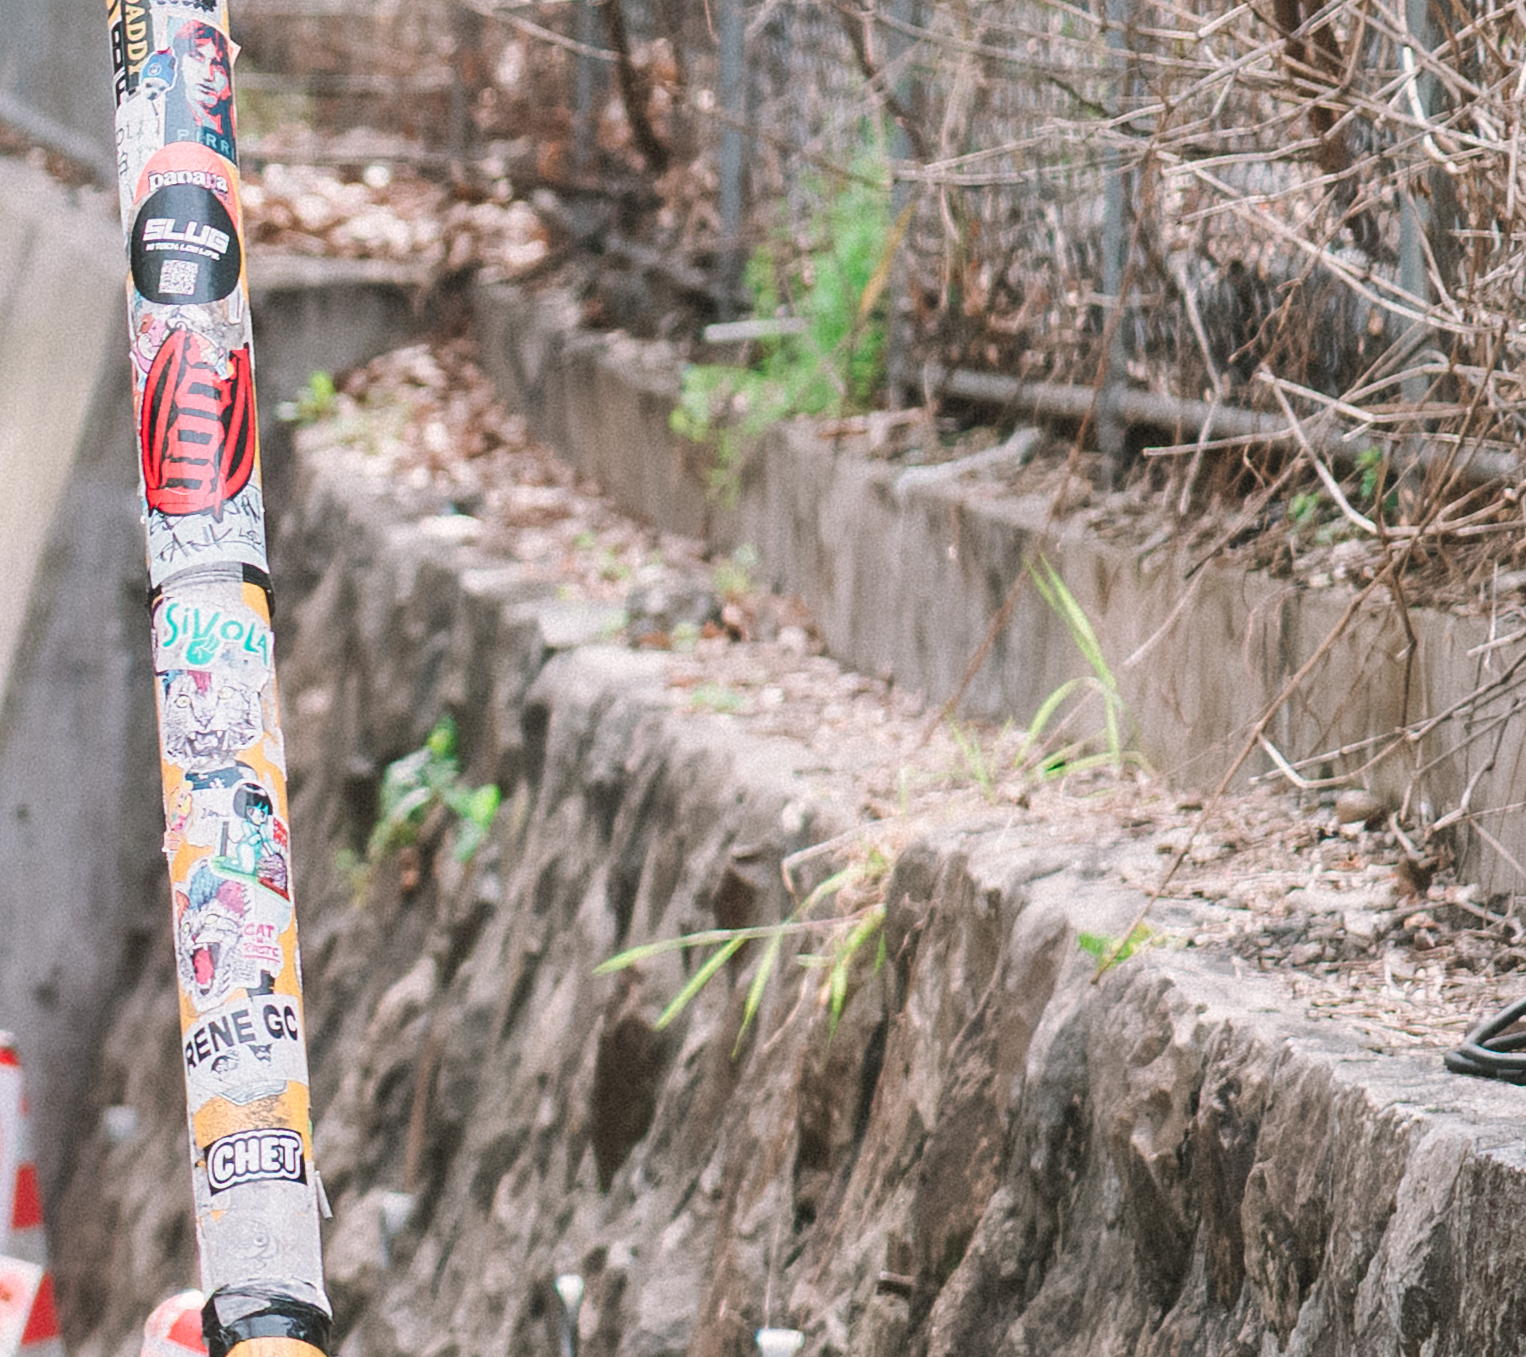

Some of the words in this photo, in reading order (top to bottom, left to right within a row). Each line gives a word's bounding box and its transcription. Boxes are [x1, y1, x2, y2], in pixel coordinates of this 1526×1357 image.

[142, 217, 231, 255] SLUG
[243, 922, 275, 938] CAT
[212, 1133, 301, 1184] CHET
